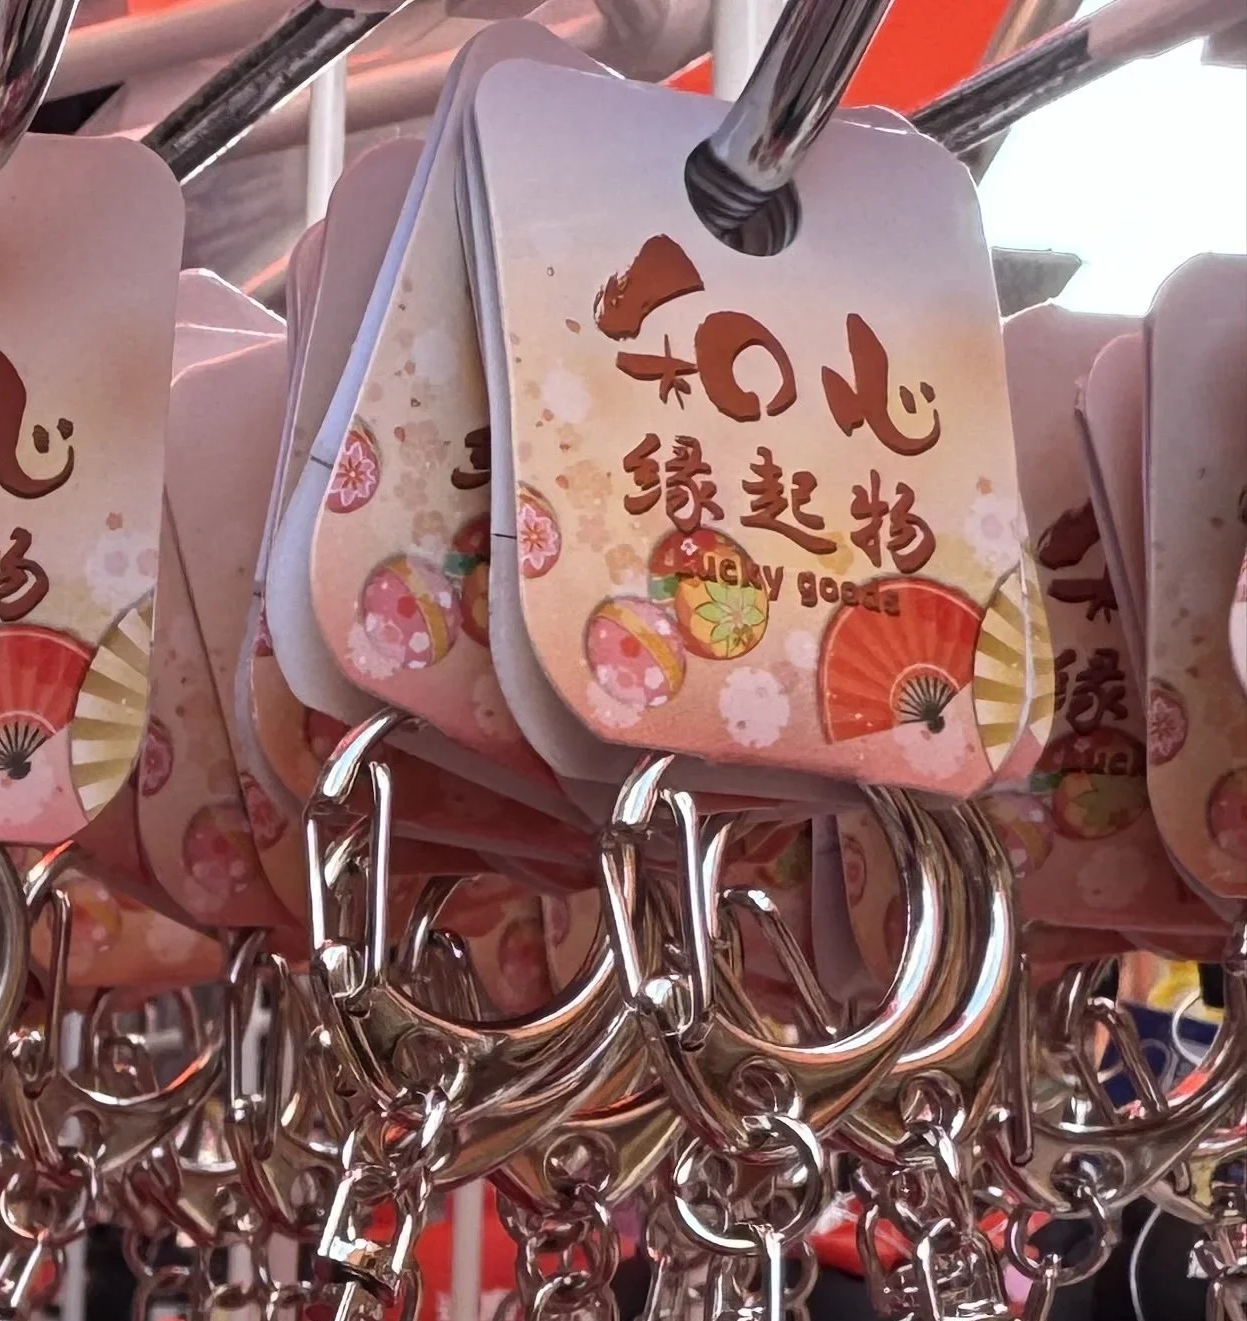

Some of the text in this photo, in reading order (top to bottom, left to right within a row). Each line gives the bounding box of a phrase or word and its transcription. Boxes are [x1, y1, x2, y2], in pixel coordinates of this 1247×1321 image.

[622, 432, 937, 576] 縁起物
[675, 550, 901, 617] Lucky goods
